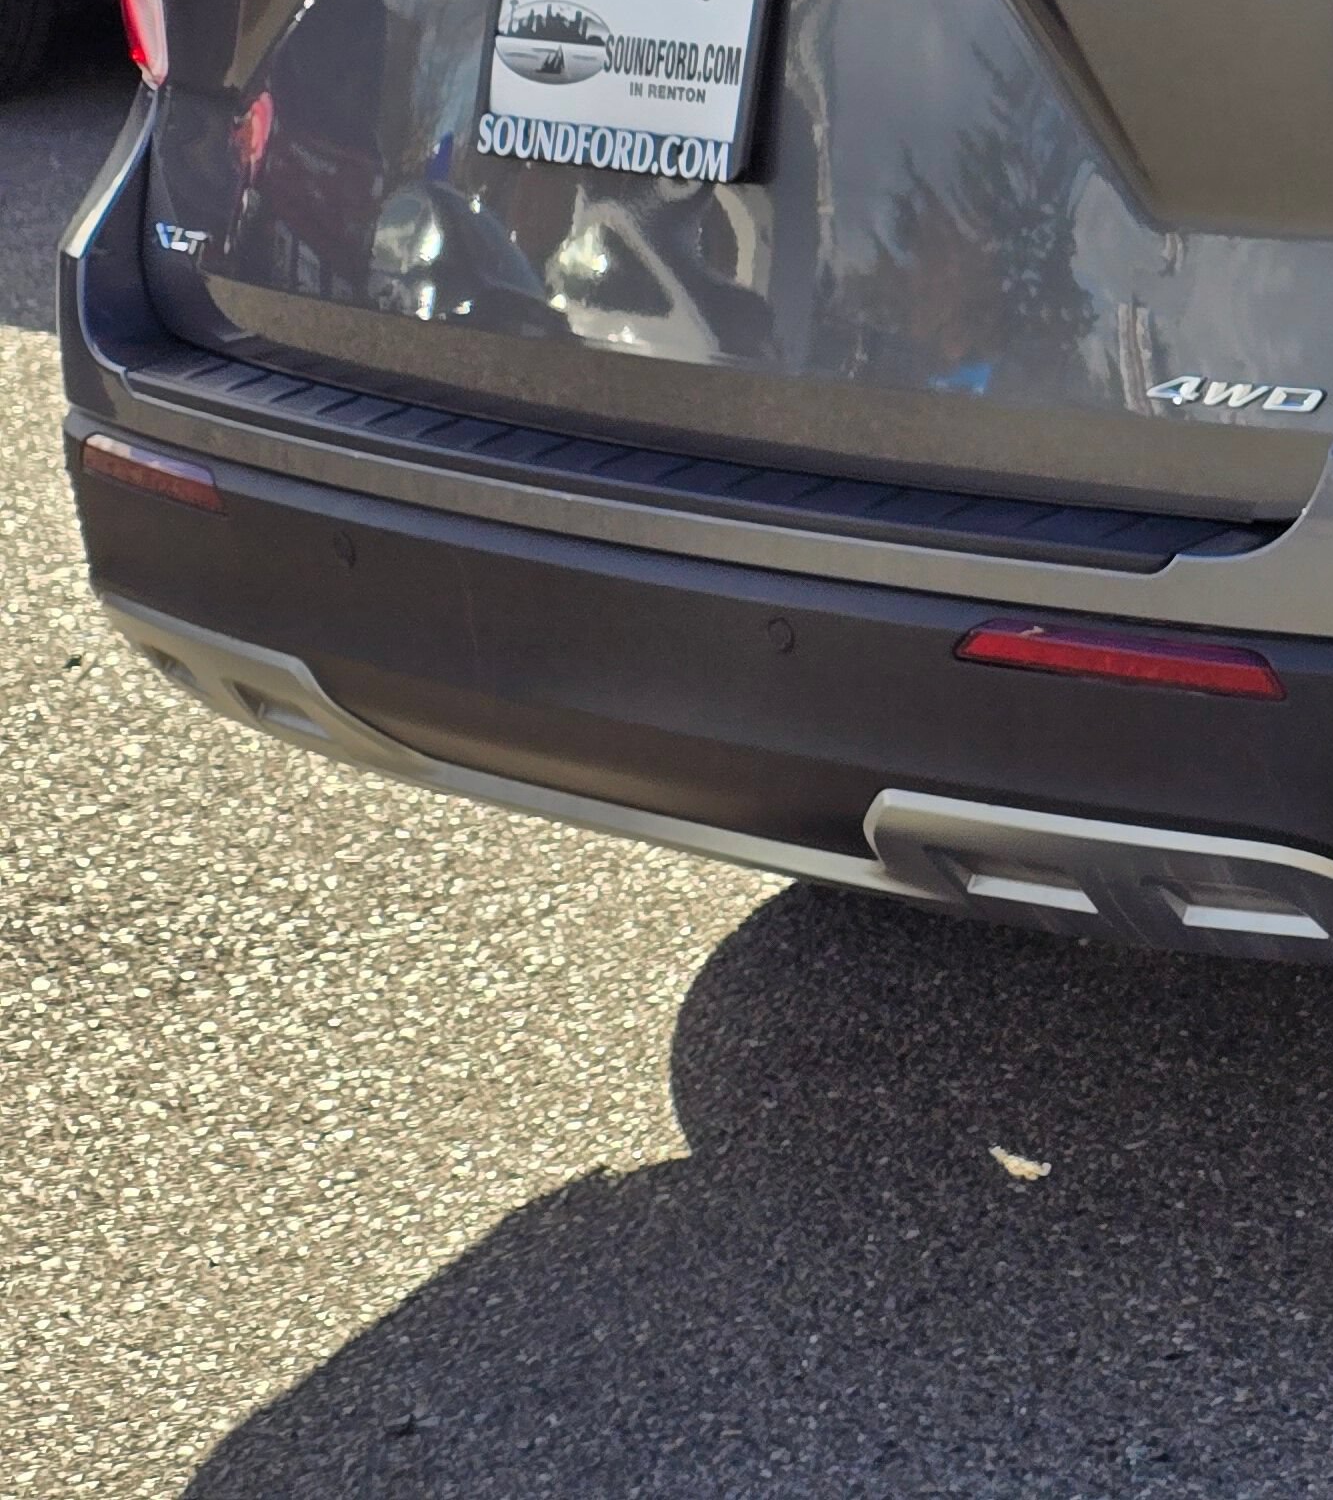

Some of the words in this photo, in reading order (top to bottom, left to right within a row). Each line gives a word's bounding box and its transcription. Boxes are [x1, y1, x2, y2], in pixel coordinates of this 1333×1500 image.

[603, 34, 743, 86] SOUNDFORD.COM
[629, 82, 644, 98] IN
[648, 83, 706, 104] RENTON
[477, 113, 729, 183] SOUNDFORD.COM
[155, 222, 207, 255] XLT
[1146, 376, 1327, 412] 4WD
